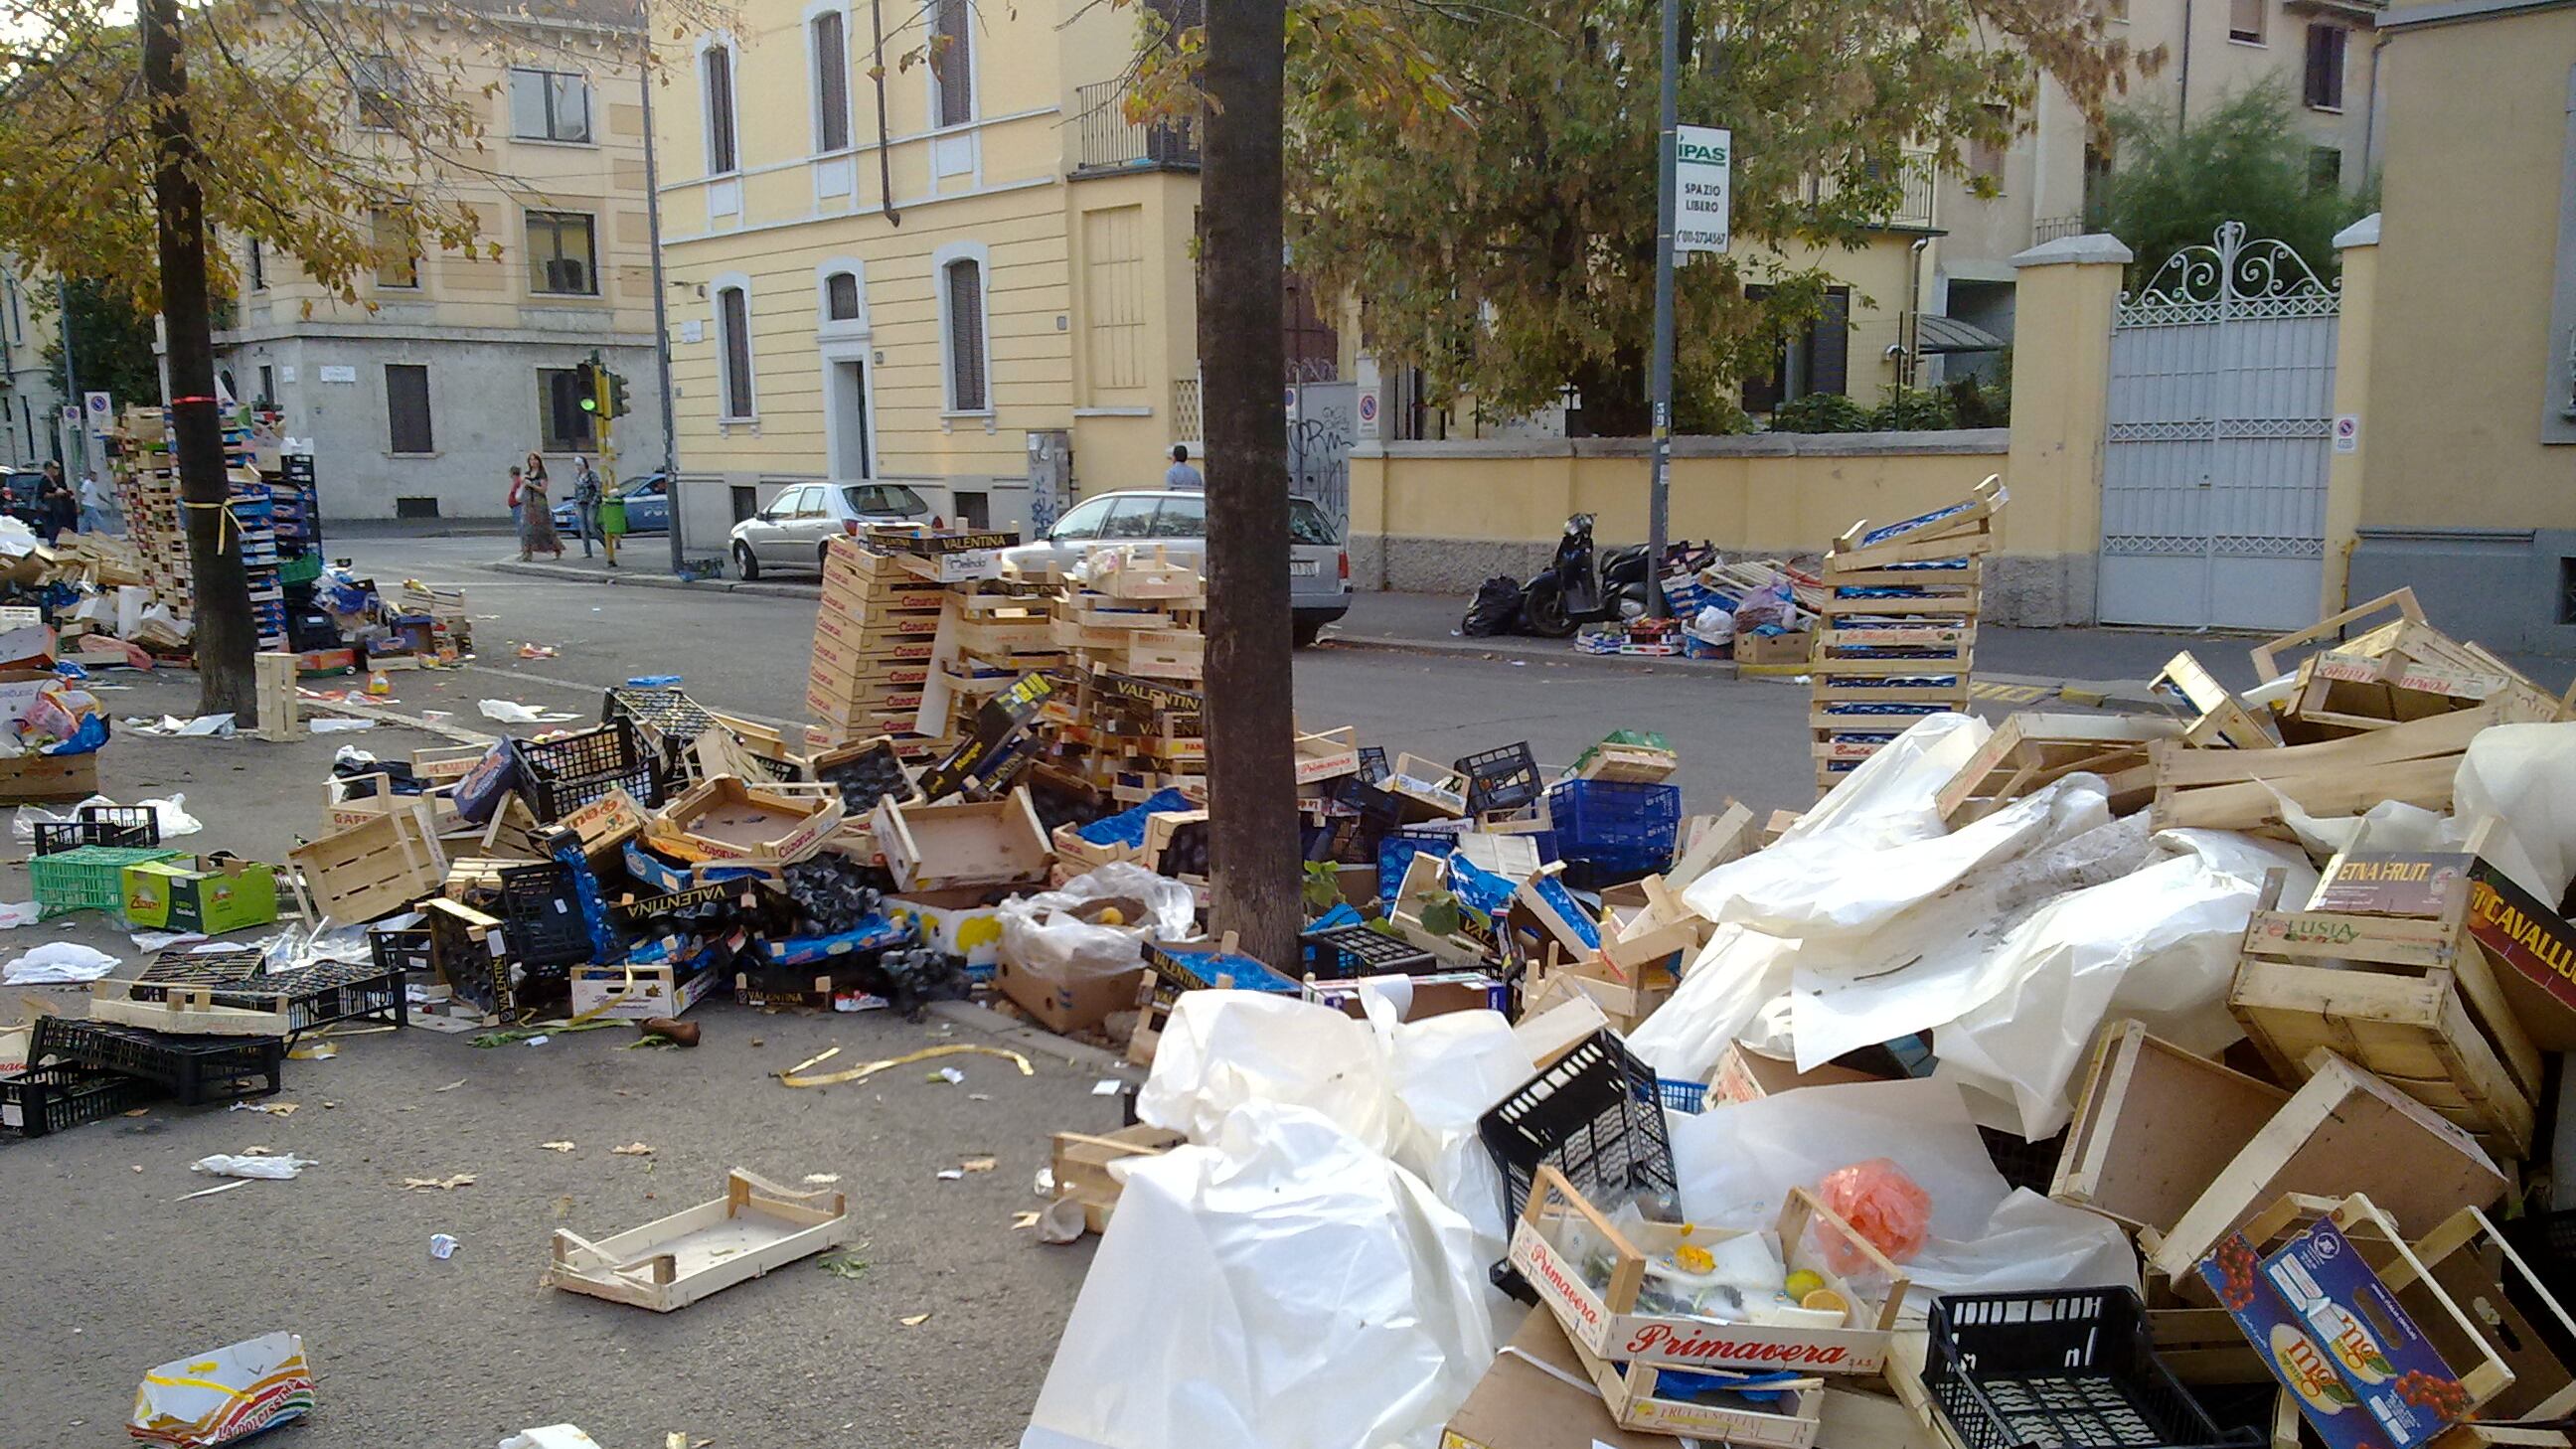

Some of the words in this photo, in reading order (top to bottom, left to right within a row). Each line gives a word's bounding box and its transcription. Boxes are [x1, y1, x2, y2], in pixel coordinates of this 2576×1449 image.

[1685, 183, 1721, 196] SPAZIO
[1686, 200, 1719, 213] LIBERO
[942, 535, 1007, 550] VALENTINA
[1116, 680, 1200, 710] VALENTIN
[2336, 862, 2379, 882] ETNA
[2379, 861, 2433, 882] FRUIT
[627, 884, 726, 918] VALENTINA
[2286, 918, 2360, 940] LUSIA
[492, 955, 512, 1012] VALENTIN
[746, 992, 804, 1004] VALENTINA
[1530, 1243, 1598, 1325] Primavera
[1626, 1323, 1851, 1366] Primavera
